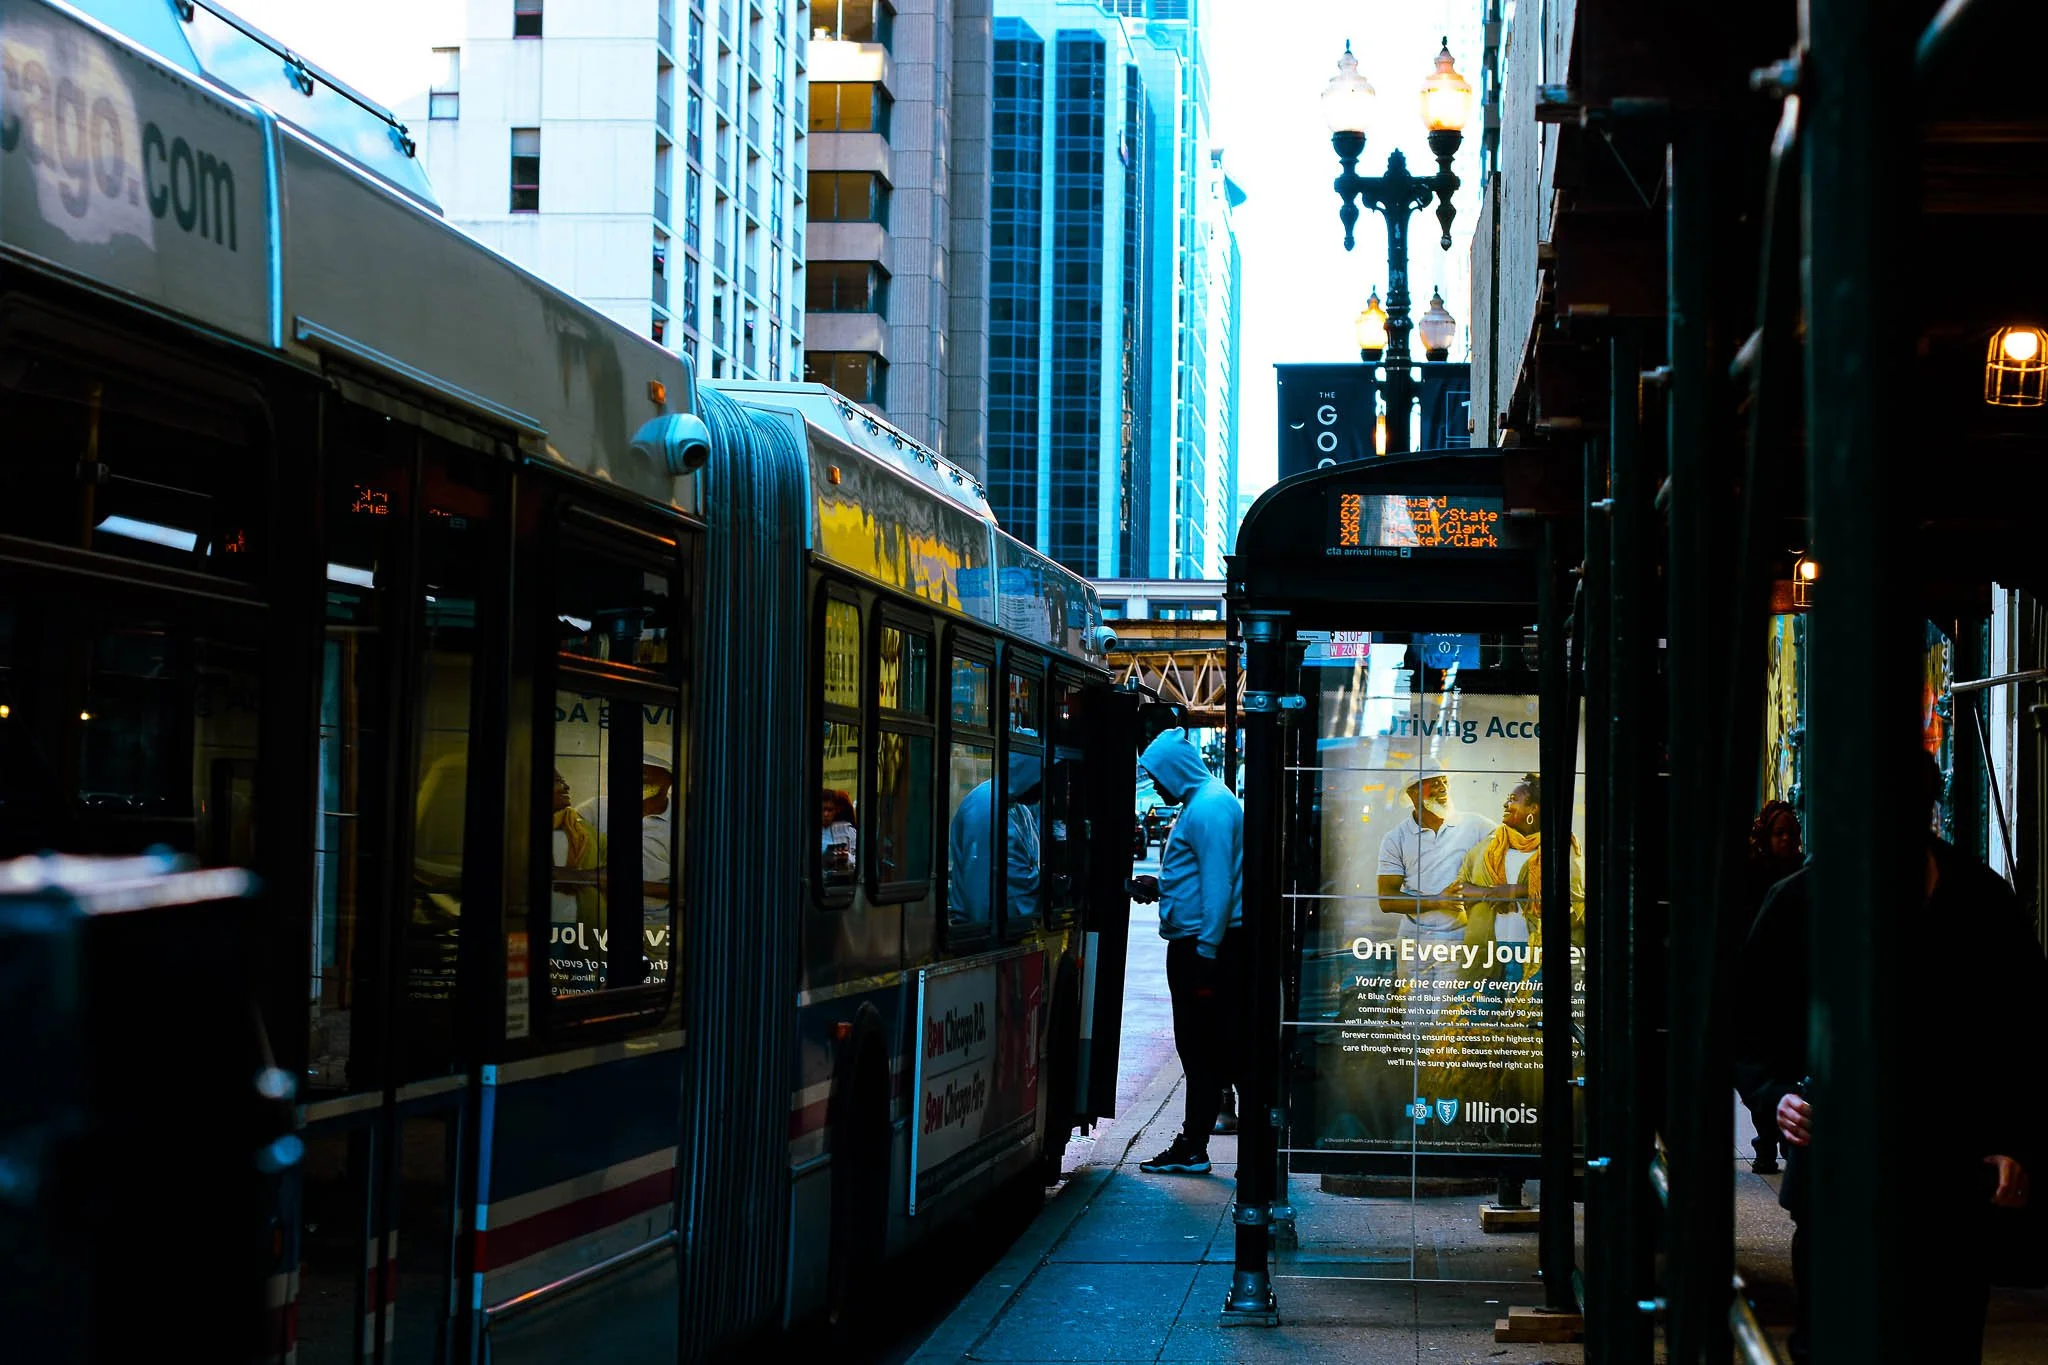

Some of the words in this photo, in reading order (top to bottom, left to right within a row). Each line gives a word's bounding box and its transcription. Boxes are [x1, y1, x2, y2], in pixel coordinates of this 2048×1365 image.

[1319, 391, 1336, 399] THE
[1340, 494, 1360, 507] 22
[1340, 507, 1360, 520] 62
[1340, 520, 1360, 532] 36
[1340, 532, 1360, 546] 24
[1326, 547, 1342, 556] cta
[1344, 547, 1372, 556] arrival
[1374, 547, 1398, 556] times
[1339, 631, 1362, 642] STOP
[1342, 644, 1365, 656] ZONE
[1352, 937, 1392, 960] On
[1401, 938, 1479, 969] Every
[1355, 975, 1391, 988] You're
[1394, 978, 1407, 989] at
[1409, 979, 1429, 989] the
[1432, 979, 1470, 990] center
[1473, 978, 1487, 993] of
[1368, 993, 1384, 1001] Blue
[1386, 993, 1406, 1001] Cross
[1424, 994, 1440, 1002] Blue
[1442, 994, 1465, 1003] Shield
[1467, 995, 1475, 1003] of
[1504, 996, 1526, 1004] we've
[1358, 1005, 1407, 1014] communities
[1408, 1006, 1425, 1014] with
[1441, 1007, 1477, 1016] members
[1478, 1008, 1489, 1016] for
[1491, 1008, 1515, 1018] nearly
[1516, 1009, 1526, 1017] 90
[928, 1016, 944, 1058] 8PM
[945, 1007, 973, 1057] Chicago
[1341, 1031, 1369, 1039] forever
[1370, 1031, 1411, 1040] committed
[1422, 1033, 1455, 1043] ensuring
[1492, 1034, 1505, 1042] the
[1506, 1035, 1535, 1044] highest
[1361, 1044, 1391, 1054] through
[1393, 1046, 1413, 1055] every
[1436, 1046, 1445, 1054] of
[1461, 1047, 1492, 1055] Because
[1494, 1047, 1529, 1056] wherever
[1387, 1058, 1405, 1066] we'll
[1446, 1061, 1460, 1069] you
[1461, 1060, 1487, 1069] always
[1489, 1060, 1503, 1069] feel
[1504, 1061, 1523, 1070] right
[925, 1092, 944, 1135] 9PM
[945, 1079, 972, 1128] Chicago
[1465, 1101, 1538, 1124] Illinois
